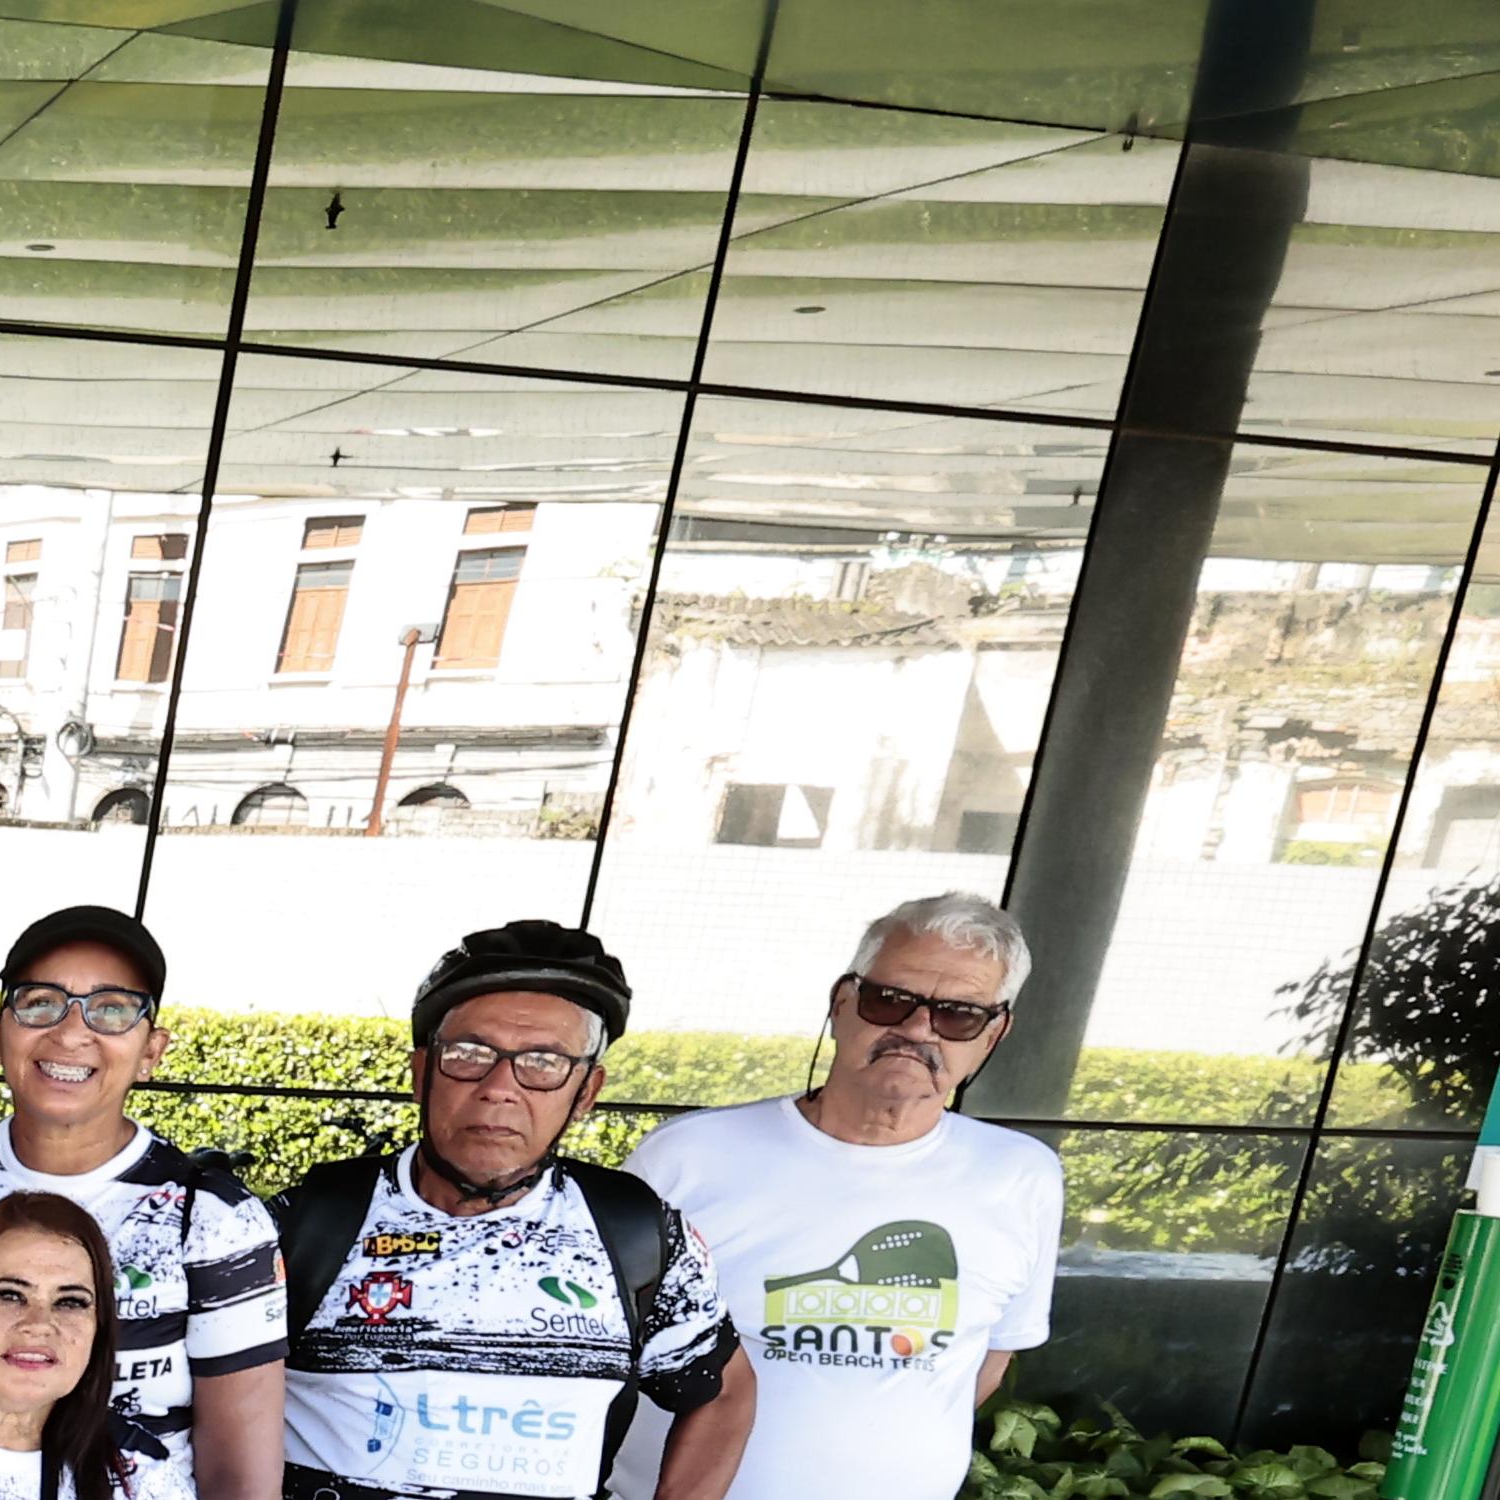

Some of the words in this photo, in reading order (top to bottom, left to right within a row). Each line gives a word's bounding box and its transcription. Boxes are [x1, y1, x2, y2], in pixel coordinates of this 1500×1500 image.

[818, 1352, 884, 1369] BEACH
[416, 1391, 578, 1442] Ltrês
[412, 1447, 568, 1478] SEGUROS
